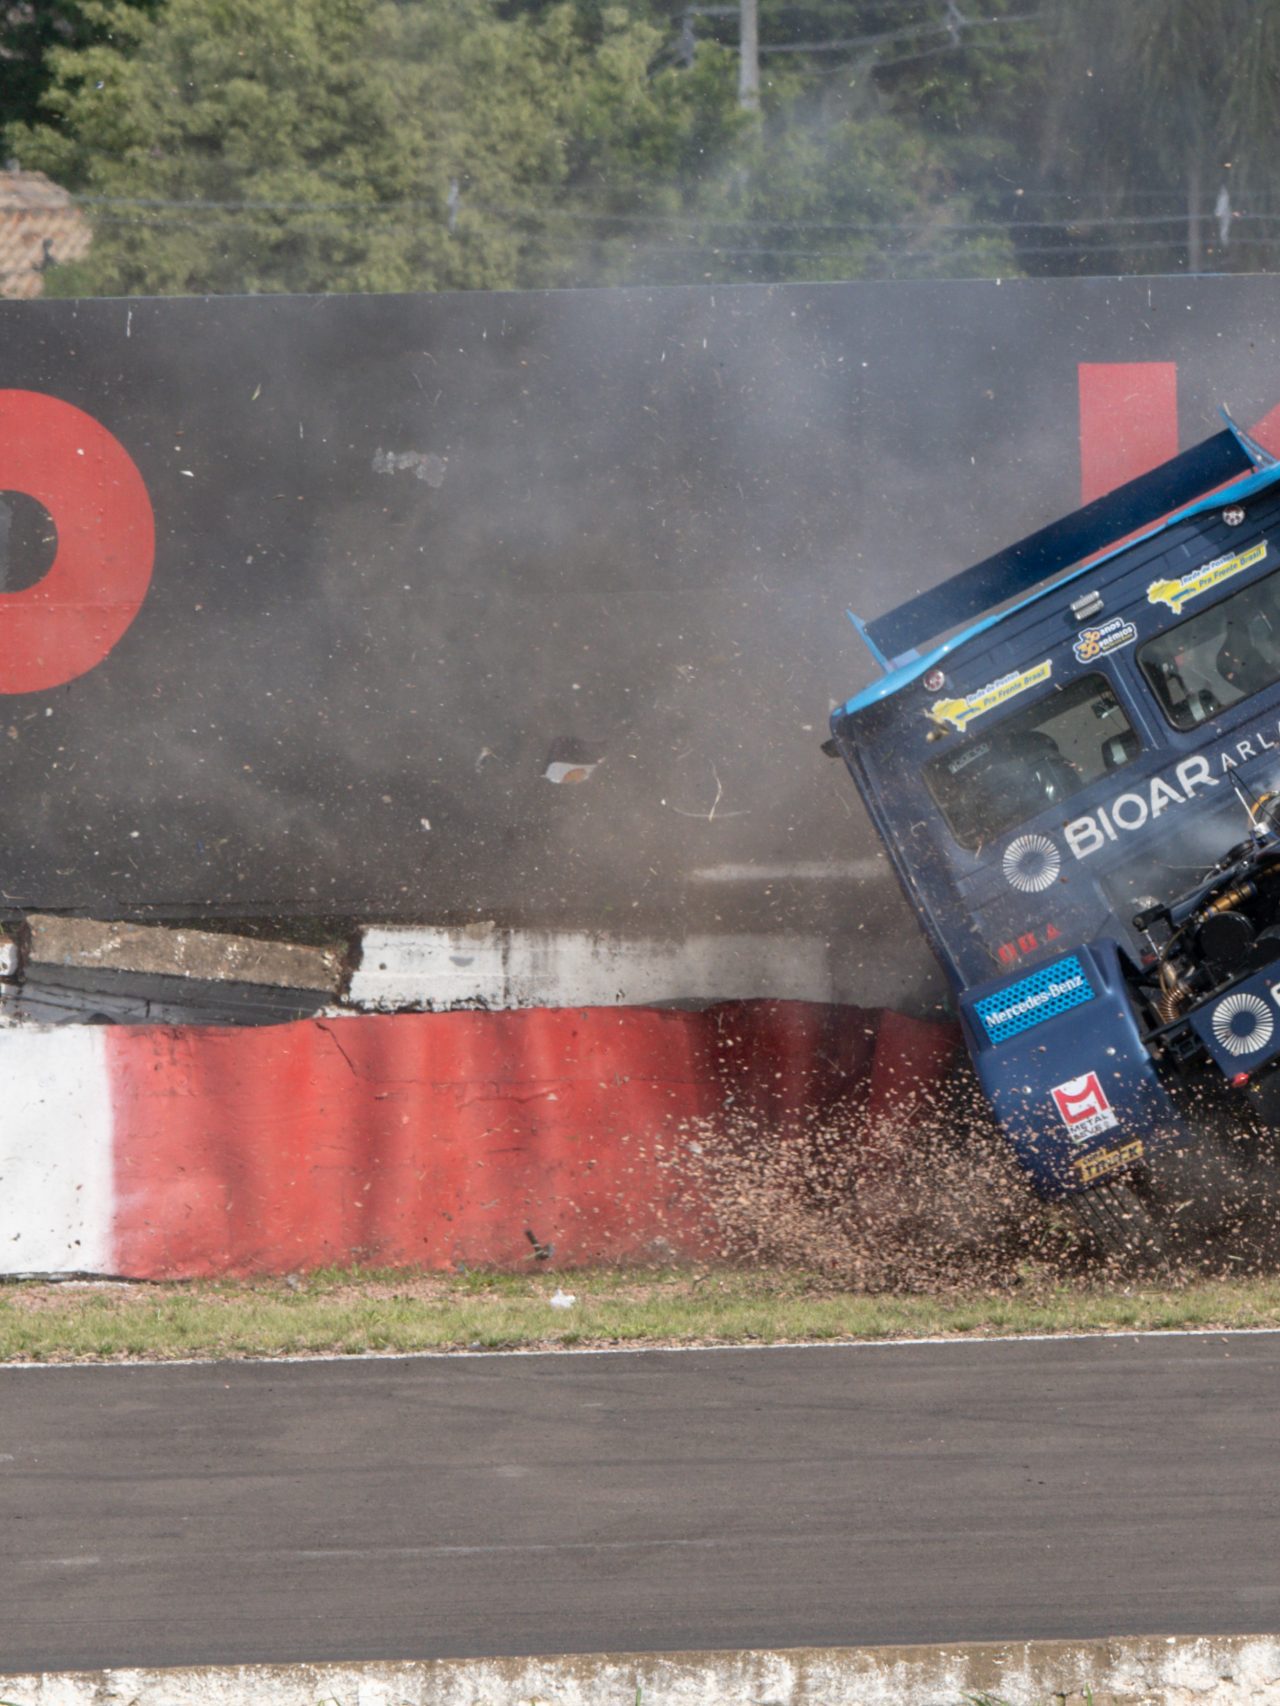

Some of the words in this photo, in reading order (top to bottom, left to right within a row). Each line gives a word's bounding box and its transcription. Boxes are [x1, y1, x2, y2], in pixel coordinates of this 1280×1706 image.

[1214, 562, 1239, 580] Frente
[1240, 549, 1262, 566] Brasil
[998, 681, 1022, 698] Frente
[1023, 668, 1046, 685] Brasil
[1063, 755, 1220, 860] BIOAR
[985, 975, 1083, 1028] Mercedes-Benz
[1070, 1113, 1109, 1133] METAL
